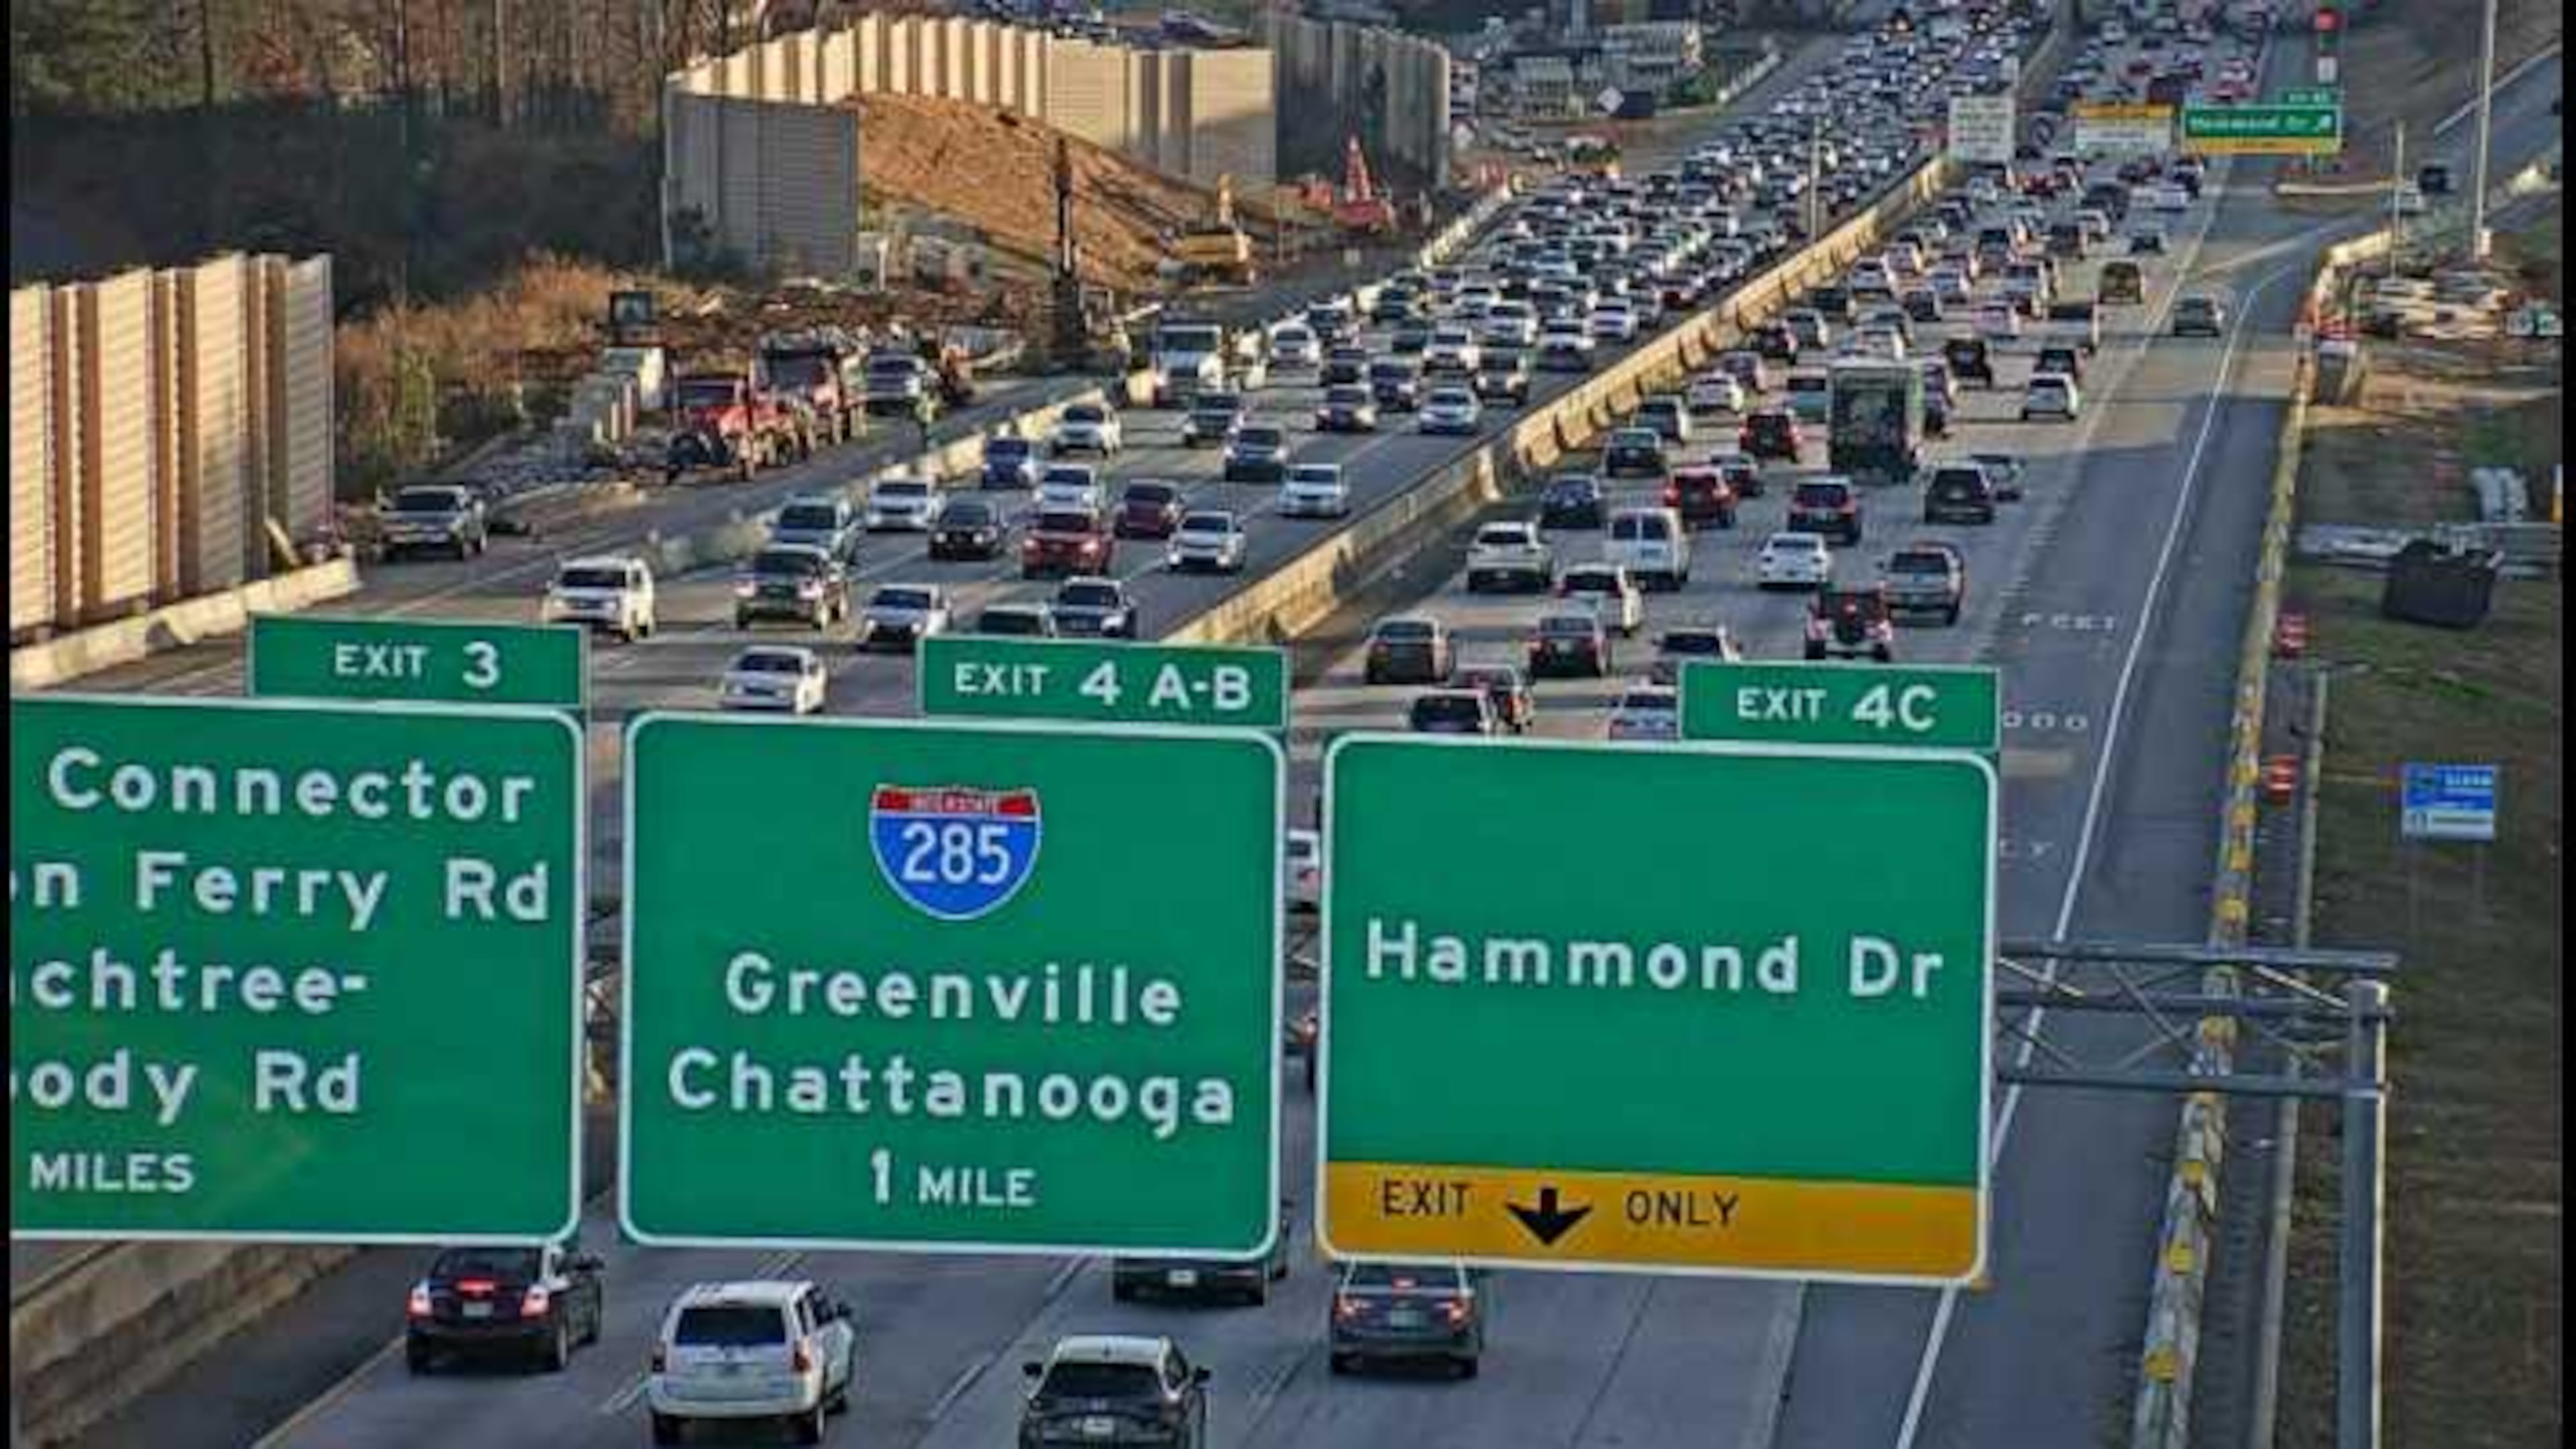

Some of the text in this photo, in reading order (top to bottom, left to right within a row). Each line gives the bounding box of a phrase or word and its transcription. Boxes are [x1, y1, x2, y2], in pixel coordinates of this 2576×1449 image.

[335, 641, 500, 688] EXIT 3
[955, 660, 1251, 710] EXIT 4 A-B
[1737, 684, 1936, 731] EXIT 4C
[48, 747, 534, 822] Connector
[902, 821, 1010, 885] 285
[11, 851, 548, 932] n Ferry Rd
[11, 947, 367, 1014] chtree-
[725, 952, 1180, 1024] Greenville
[1367, 918, 1943, 998] Hammond Dr
[11, 1048, 359, 1126] ody Rd
[668, 1047, 1234, 1139] Chattanooga
[30, 1153, 194, 1193] MILES
[871, 1148, 1034, 1207] 1 MILE
[1383, 1180, 1737, 1226] EXIT ONLY
